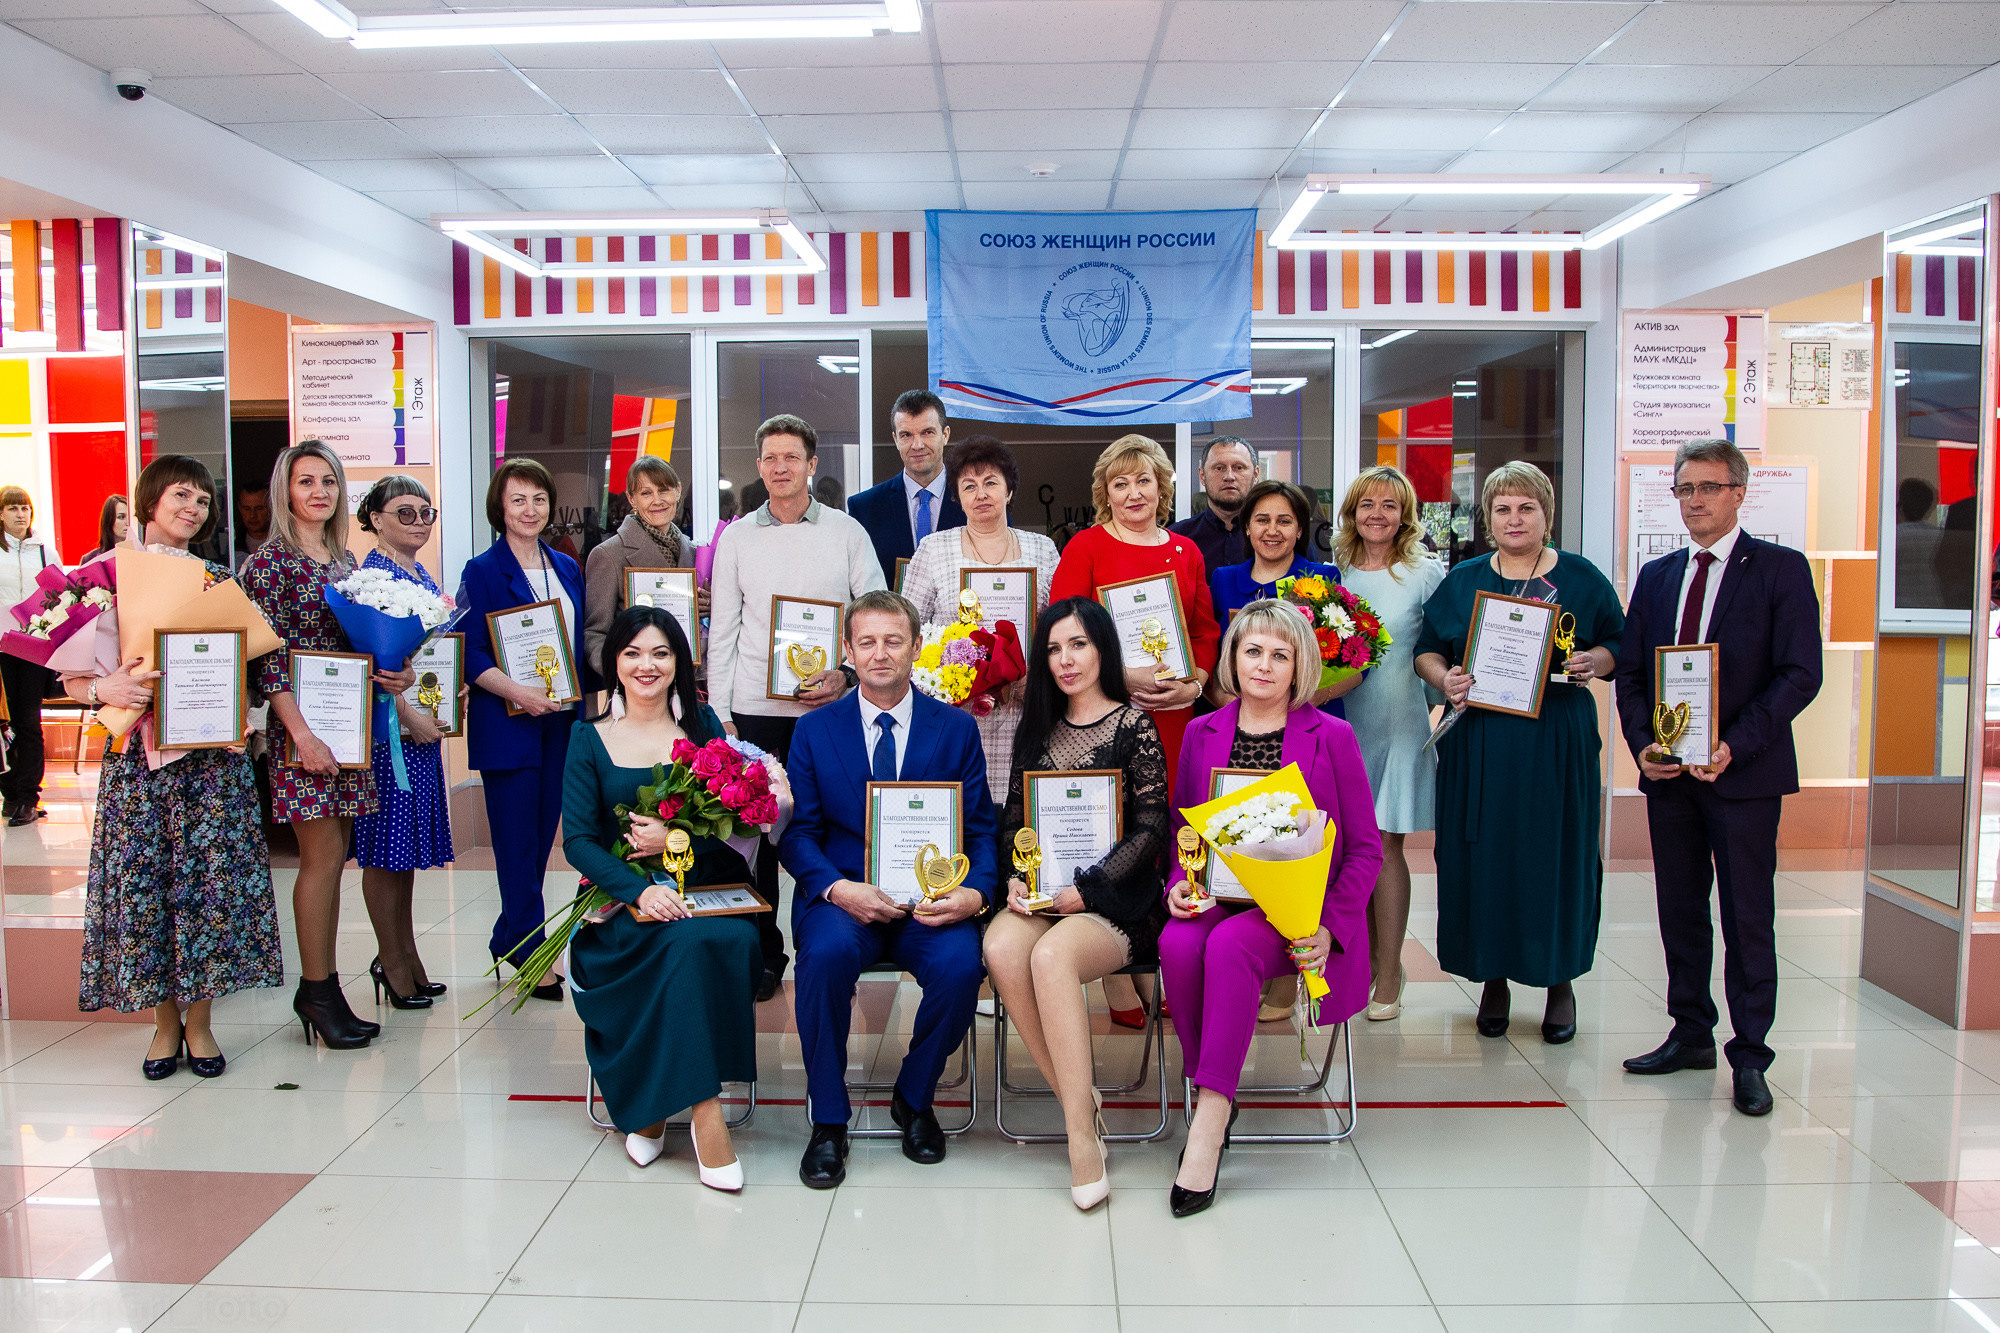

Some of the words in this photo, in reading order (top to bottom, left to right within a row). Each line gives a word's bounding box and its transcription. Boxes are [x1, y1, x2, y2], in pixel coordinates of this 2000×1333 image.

[980, 233, 1036, 249] СОЮЗ
[1042, 233, 1132, 251] ЖЕНЩИН
[1138, 232, 1216, 249] РОССИИ
[1058, 266, 1078, 281] СОЮЗ
[1078, 260, 1109, 270] ЖЕНЩИН
[1110, 264, 1136, 281] РОССИИ
[1040, 290, 1053, 313] RUSSIA
[1138, 285, 1152, 311] L'UNION
[1040, 314, 1047, 323] OF
[1634, 322, 1662, 331] АКТИВ
[1040, 324, 1053, 347] UNION
[1135, 326, 1152, 354] FEMMES
[302, 339, 364, 347] Киноконцертный
[1634, 344, 1706, 354] Администрация
[302, 358, 316, 366] Арт
[1049, 345, 1075, 369] WOMEN'S
[1128, 353, 1138, 362] DE
[1662, 356, 1697, 364] «МКДЦ»
[1096, 364, 1121, 374] RUSSIE
[1120, 360, 1128, 368] LA
[1074, 365, 1088, 374] THE
[1744, 360, 1756, 393] Этаж
[412, 378, 424, 410] Этаж
[1633, 401, 1661, 409] Студия
